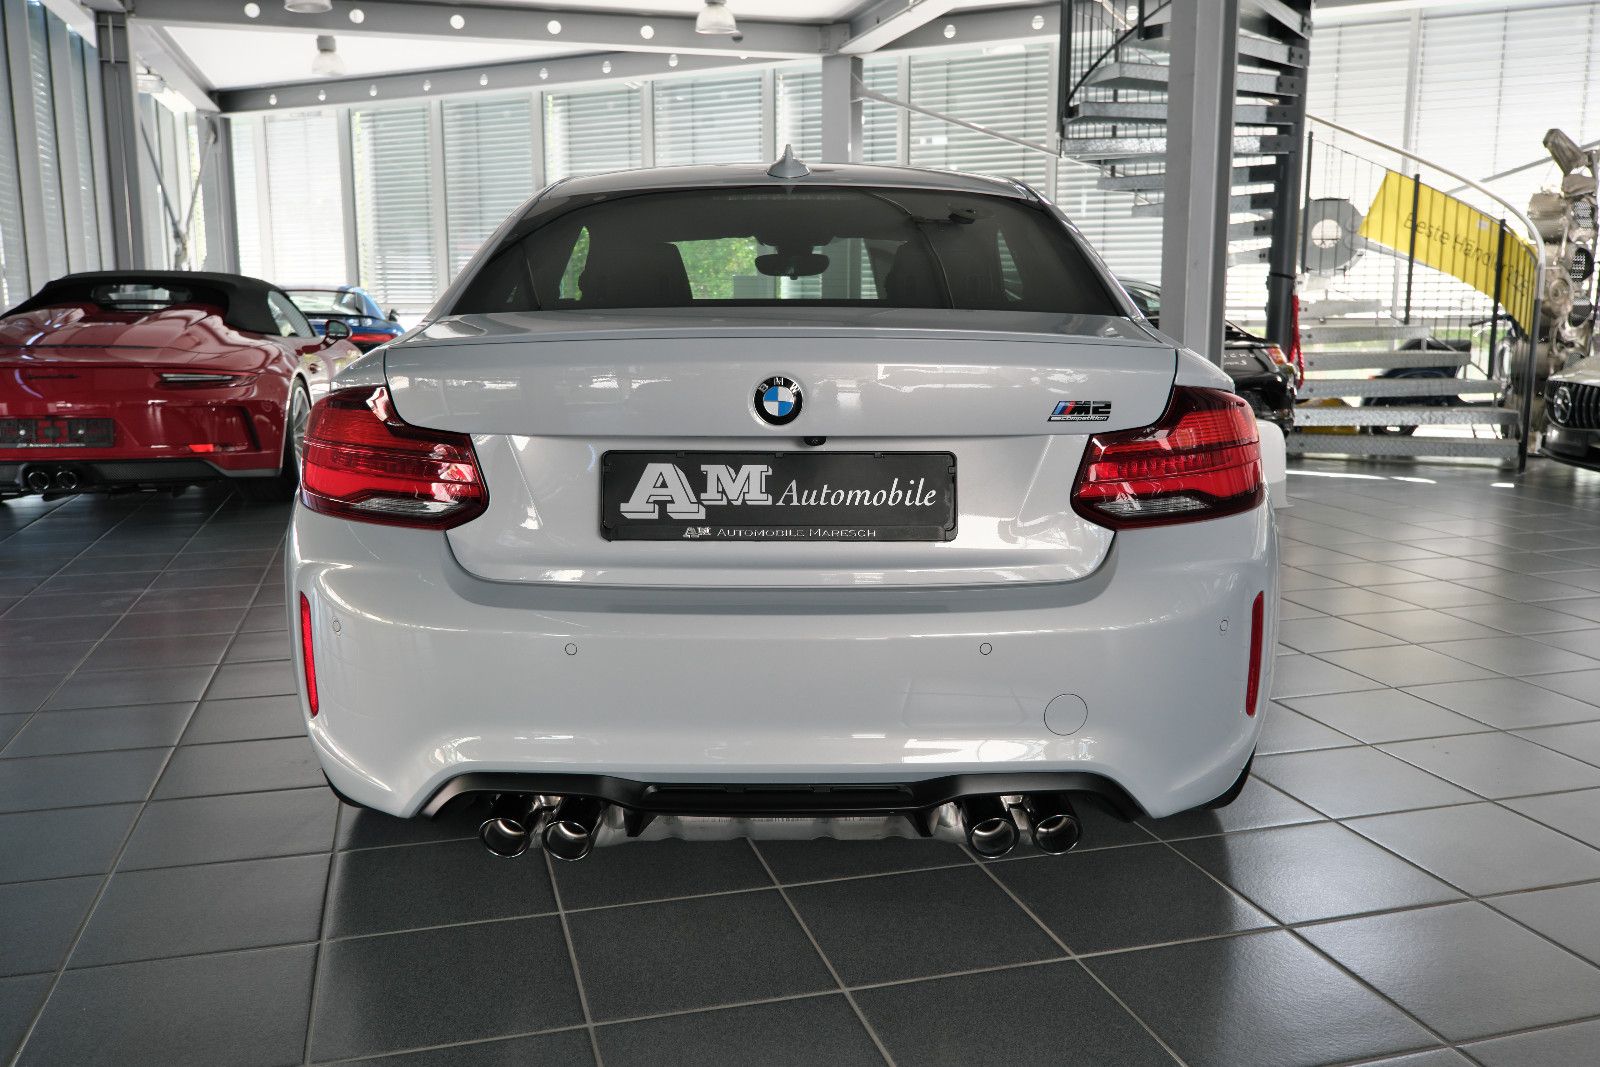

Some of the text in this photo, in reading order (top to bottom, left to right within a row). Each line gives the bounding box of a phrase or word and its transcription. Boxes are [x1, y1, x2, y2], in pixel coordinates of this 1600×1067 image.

[1403, 212, 1450, 245] Beste
[759, 377, 801, 393] BMW
[1055, 401, 1112, 415] M2
[619, 462, 937, 520] AM Automobile
